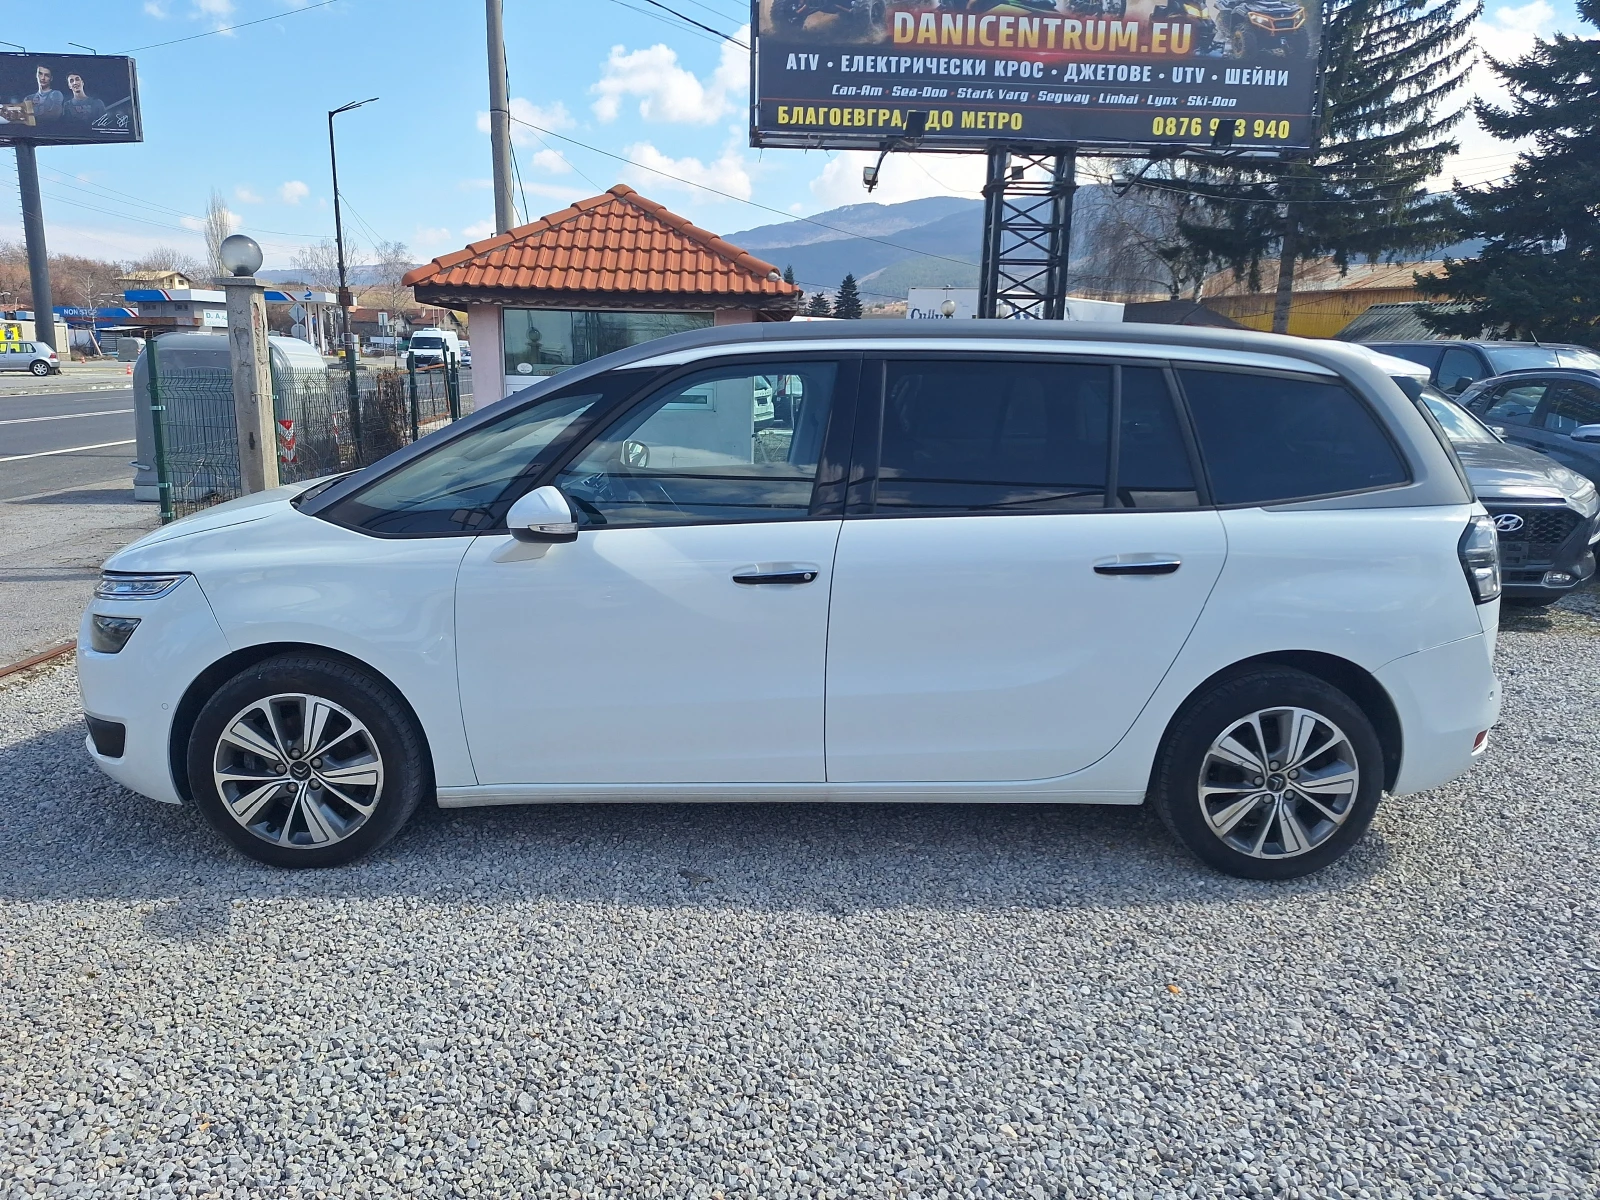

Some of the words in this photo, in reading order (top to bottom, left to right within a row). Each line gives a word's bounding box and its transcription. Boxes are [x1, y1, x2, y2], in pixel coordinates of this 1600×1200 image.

[893, 11, 1192, 55] DANICENTRUM.EU
[786, 53, 820, 71] ATV
[841, 55, 986, 77] ЕЛЕКТРИЧЕСКИ
[994, 60, 1044, 78] КРОС
[1063, 63, 1152, 83] ДЖЕТОВЕ
[1172, 67, 1206, 84] UTV
[1225, 66, 1289, 86] ШЕЙНИ
[832, 84, 883, 97] Can-Am
[892, 85, 948, 98] Sea-Doo
[957, 87, 995, 99] Stark
[998, 89, 1029, 102] Varg
[1038, 90, 1090, 105] Segway
[1098, 92, 1139, 105] Linhai
[1147, 94, 1178, 107] Lynx
[1187, 95, 1237, 107] Ski-Doo
[925, 110, 953, 131] ДО
[961, 111, 1023, 131] МЕТРО
[1152, 116, 1202, 137] 0876
[1209, 118, 1246, 138] 93
[1253, 119, 1290, 139] 940
[63, 308, 79, 316] NON
